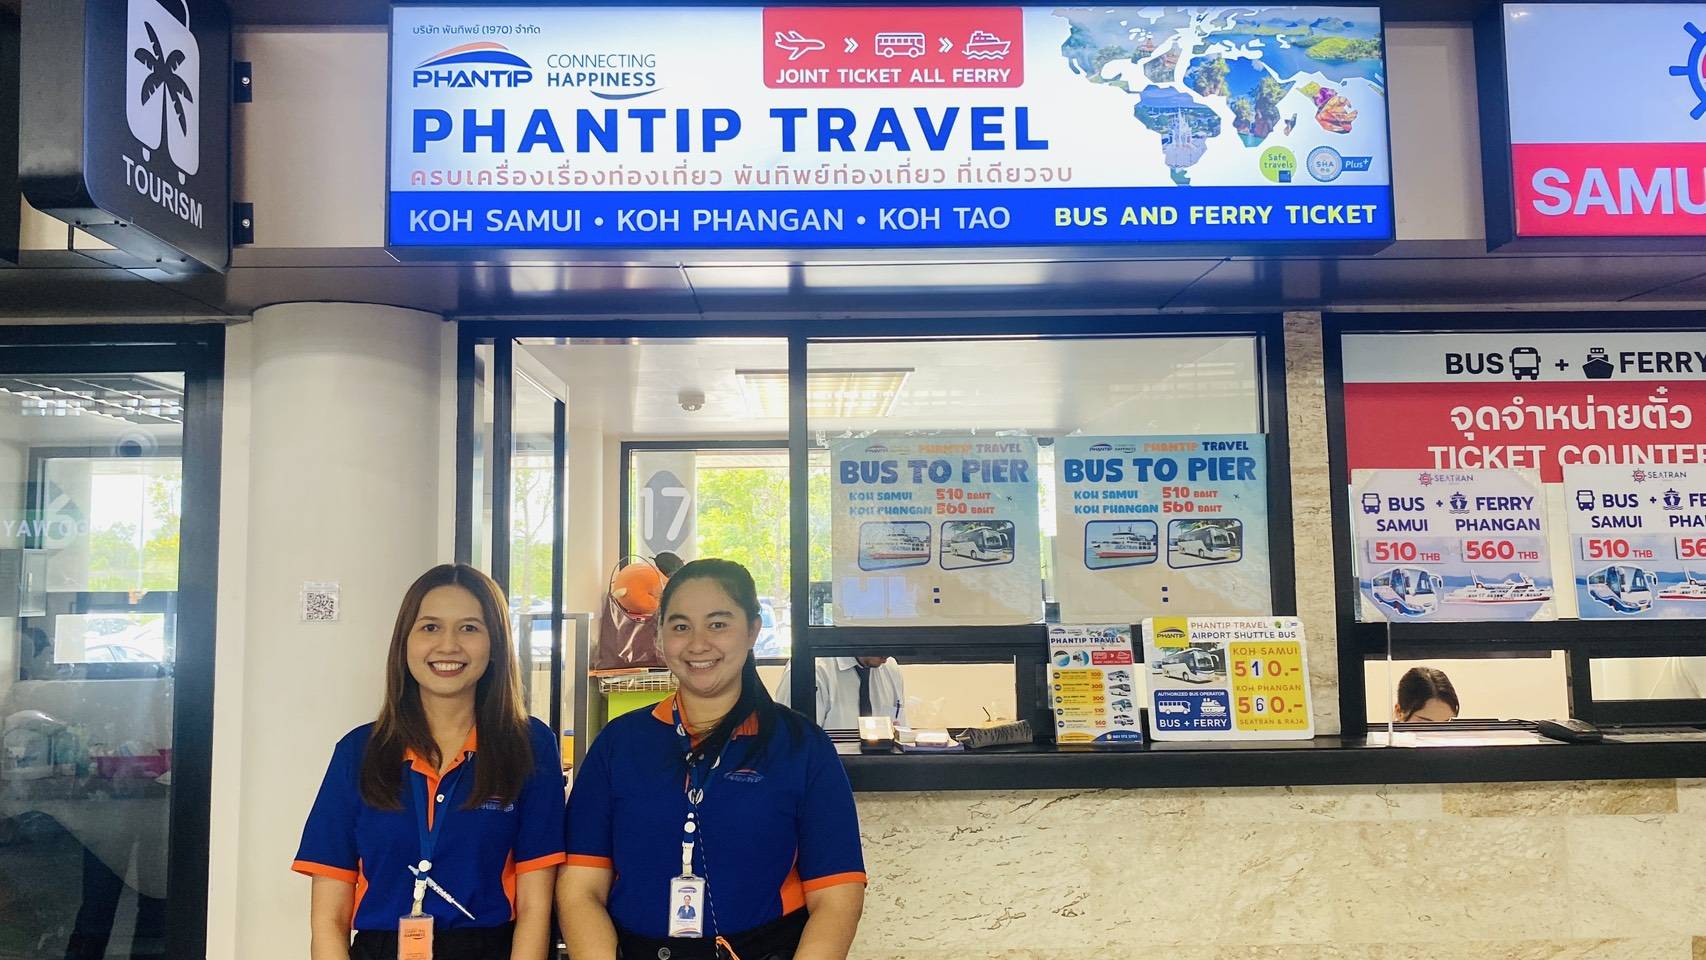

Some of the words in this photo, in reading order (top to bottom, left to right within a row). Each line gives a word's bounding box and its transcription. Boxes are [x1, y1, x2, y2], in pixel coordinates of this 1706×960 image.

[413, 24, 440, 34] บริษัท
[482, 24, 513, 35] (1970)
[515, 23, 541, 34] จำกัด
[547, 54, 656, 68] CONNECTING
[413, 70, 533, 88] PHANTIP
[548, 72, 656, 87] HAPPINESS
[776, 69, 830, 83] JOINT
[837, 68, 902, 83] TICKET
[910, 68, 945, 83] ALL
[953, 68, 1011, 82] FERRY
[412, 108, 742, 153] PHANTIP
[769, 106, 1049, 152] TRAVEL
[1268, 153, 1287, 161] Safe
[957, 156, 1073, 183] ที่เดียวจบ
[1264, 161, 1294, 169] travels
[122, 154, 203, 229] TOURISM
[409, 209, 473, 232] KOH
[486, 209, 581, 232] SAMUI
[618, 209, 680, 232] KOH
[693, 208, 844, 231] PHANGAN
[880, 207, 941, 230] KOH
[953, 207, 1010, 230] TAO
[1054, 206, 1108, 227] BUS
[1120, 205, 1178, 226] AND
[1190, 205, 1273, 225] FERRY
[1285, 204, 1377, 225] TICKET
[1445, 353, 1504, 374] BUS
[1450, 386, 1692, 441] จุดจำหน่ายตั๋ว
[976, 443, 1022, 453] TRAVEL
[1202, 441, 1249, 451] TRAVEL
[1428, 445, 1546, 469] TICKET
[840, 460, 898, 484] BUS
[907, 459, 952, 484] TO
[962, 459, 1029, 483] PIER
[1064, 459, 1123, 483] BUS
[1132, 458, 1178, 482] TO
[1188, 457, 1256, 481] PIER
[1647, 471, 1687, 479] SEATRAN
[1434, 474, 1473, 482] SEATRAN
[877, 492, 912, 501] SAMUI
[936, 488, 963, 500] 510
[1074, 490, 1099, 499] KOH
[1102, 490, 1138, 499] SAMUI
[1162, 487, 1190, 498] 510
[1194, 490, 1218, 498] BAHT
[1602, 493, 1639, 508] BUS
[877, 506, 932, 515] PHANGAN
[936, 503, 967, 514] 560
[1074, 505, 1099, 513] KOH
[1102, 504, 1158, 513] PHANGAN
[1163, 501, 1194, 513] 560
[1388, 497, 1425, 511] BUS
[1476, 496, 1534, 511] FERRY
[640, 486, 691, 541] 17
[1377, 519, 1428, 531] SAMUI
[1456, 518, 1540, 531] PHANGAN
[1591, 515, 1642, 528] SAMUI
[1375, 542, 1417, 560] 510
[1420, 552, 1440, 561] THB
[1466, 541, 1515, 560] 560
[1518, 552, 1538, 560] THB
[1589, 539, 1630, 559] 510
[1632, 550, 1653, 558] THB
[1234, 621, 1268, 629] TRAVEL
[1089, 636, 1121, 644] TRAVEL
[1261, 647, 1298, 655] SAMUI
[1159, 719, 1181, 728] BUS
[1194, 719, 1227, 727] FERRY
